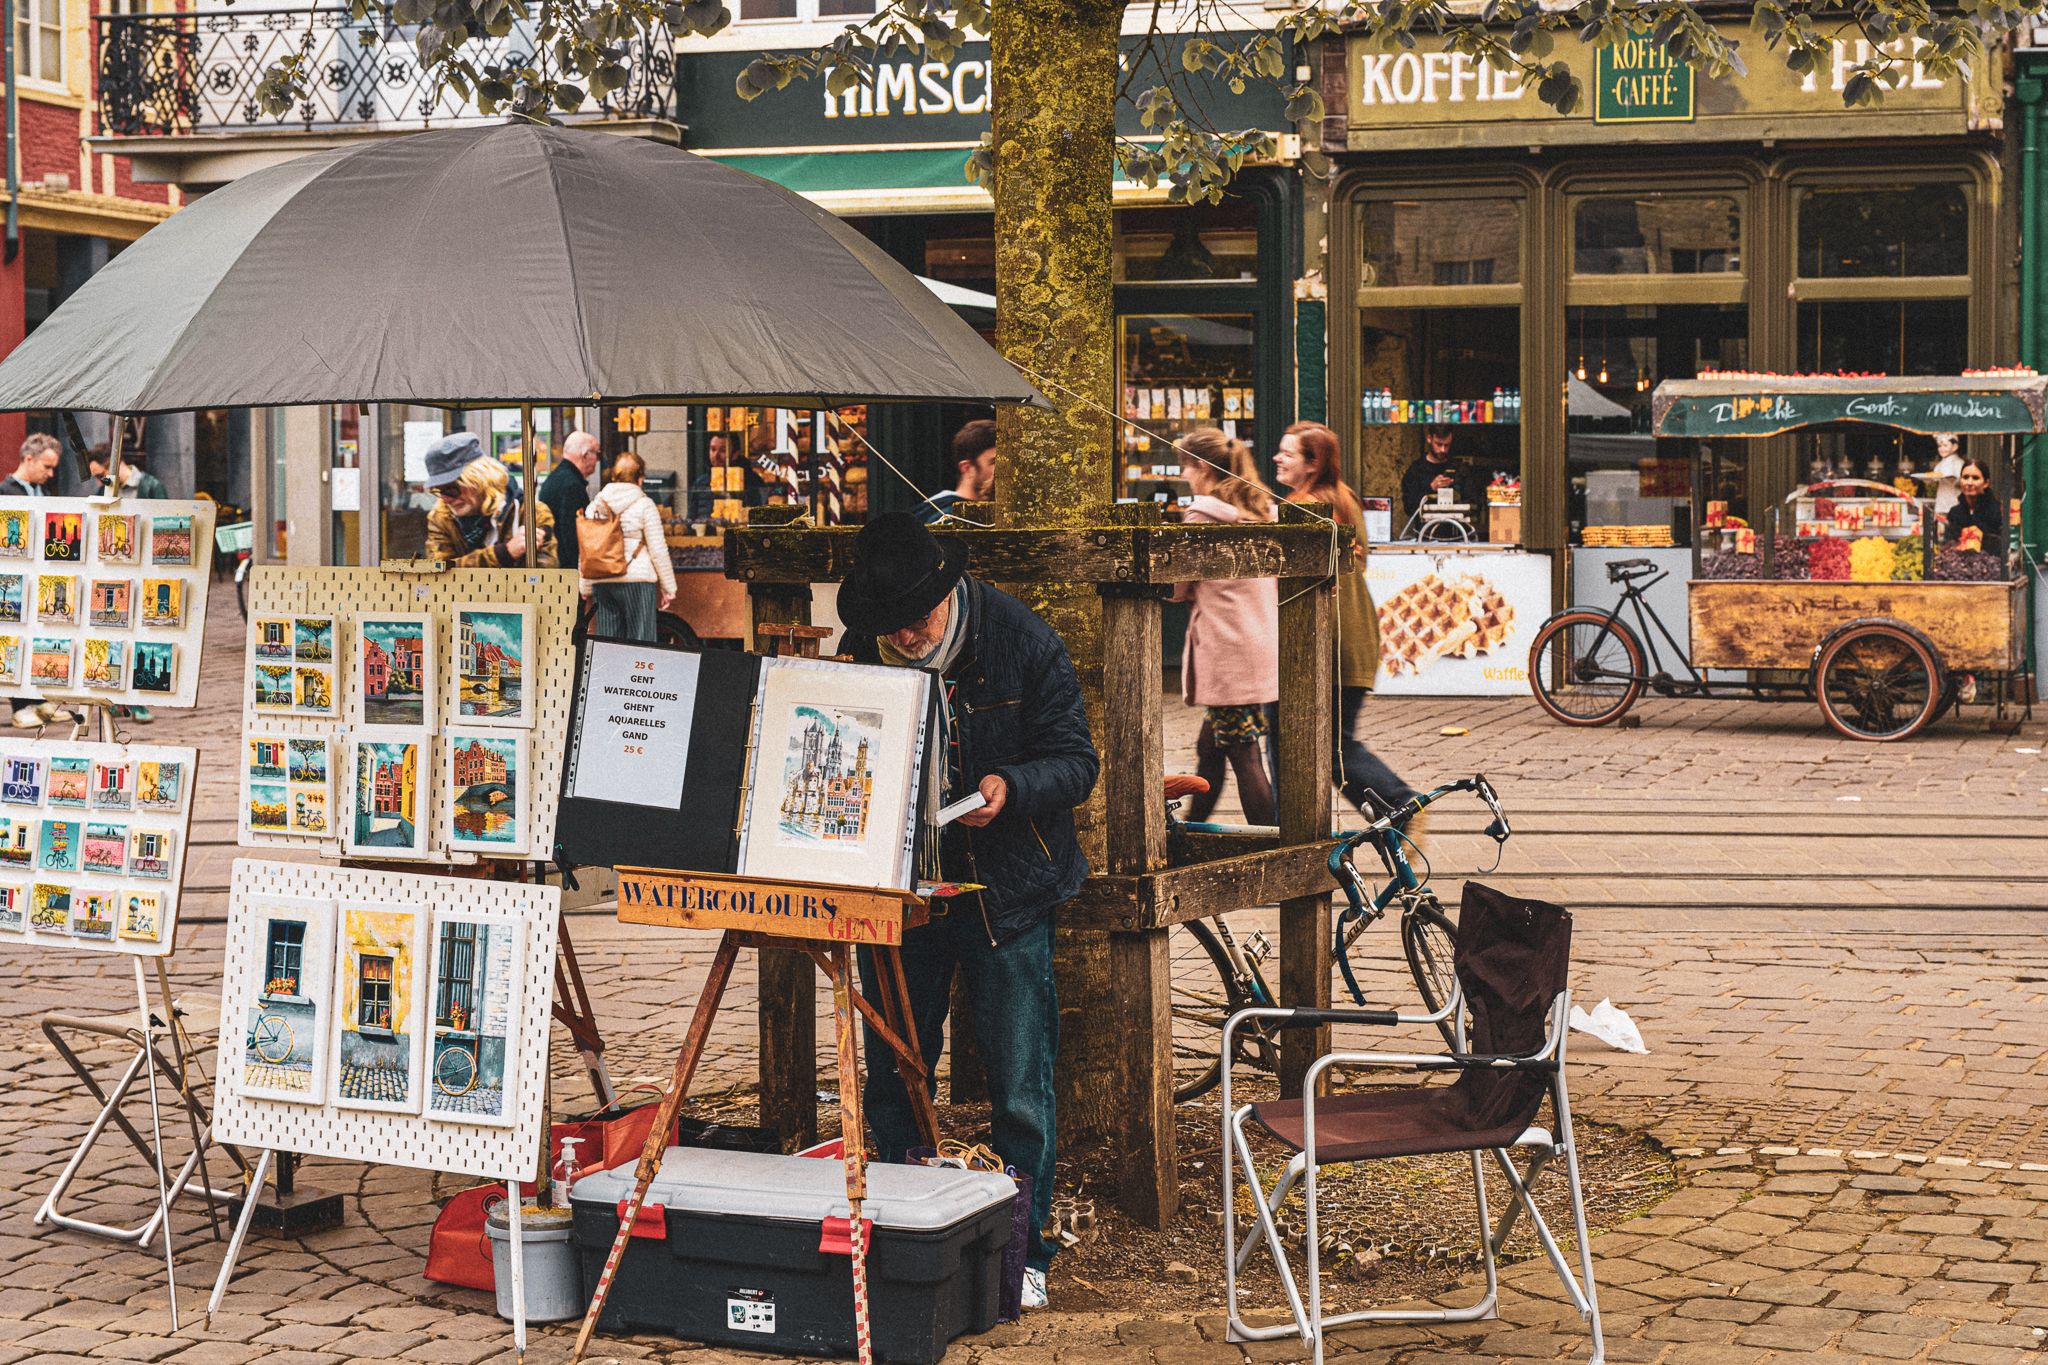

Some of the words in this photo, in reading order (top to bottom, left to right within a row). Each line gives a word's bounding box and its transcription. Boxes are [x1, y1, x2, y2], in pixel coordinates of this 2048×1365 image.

[634, 661, 646, 670] 25
[647, 662, 655, 671] €
[630, 675, 655, 685] GENT
[604, 686, 678, 701] WATERCOLOURS
[623, 702, 655, 713] GHENT
[608, 715, 666, 729] AQUARELLES
[622, 730, 649, 741] GAND
[623, 744, 635, 754] 25
[636, 746, 644, 755] €
[622, 881, 838, 920] WATERCOLOURS
[827, 917, 899, 944] GENT
